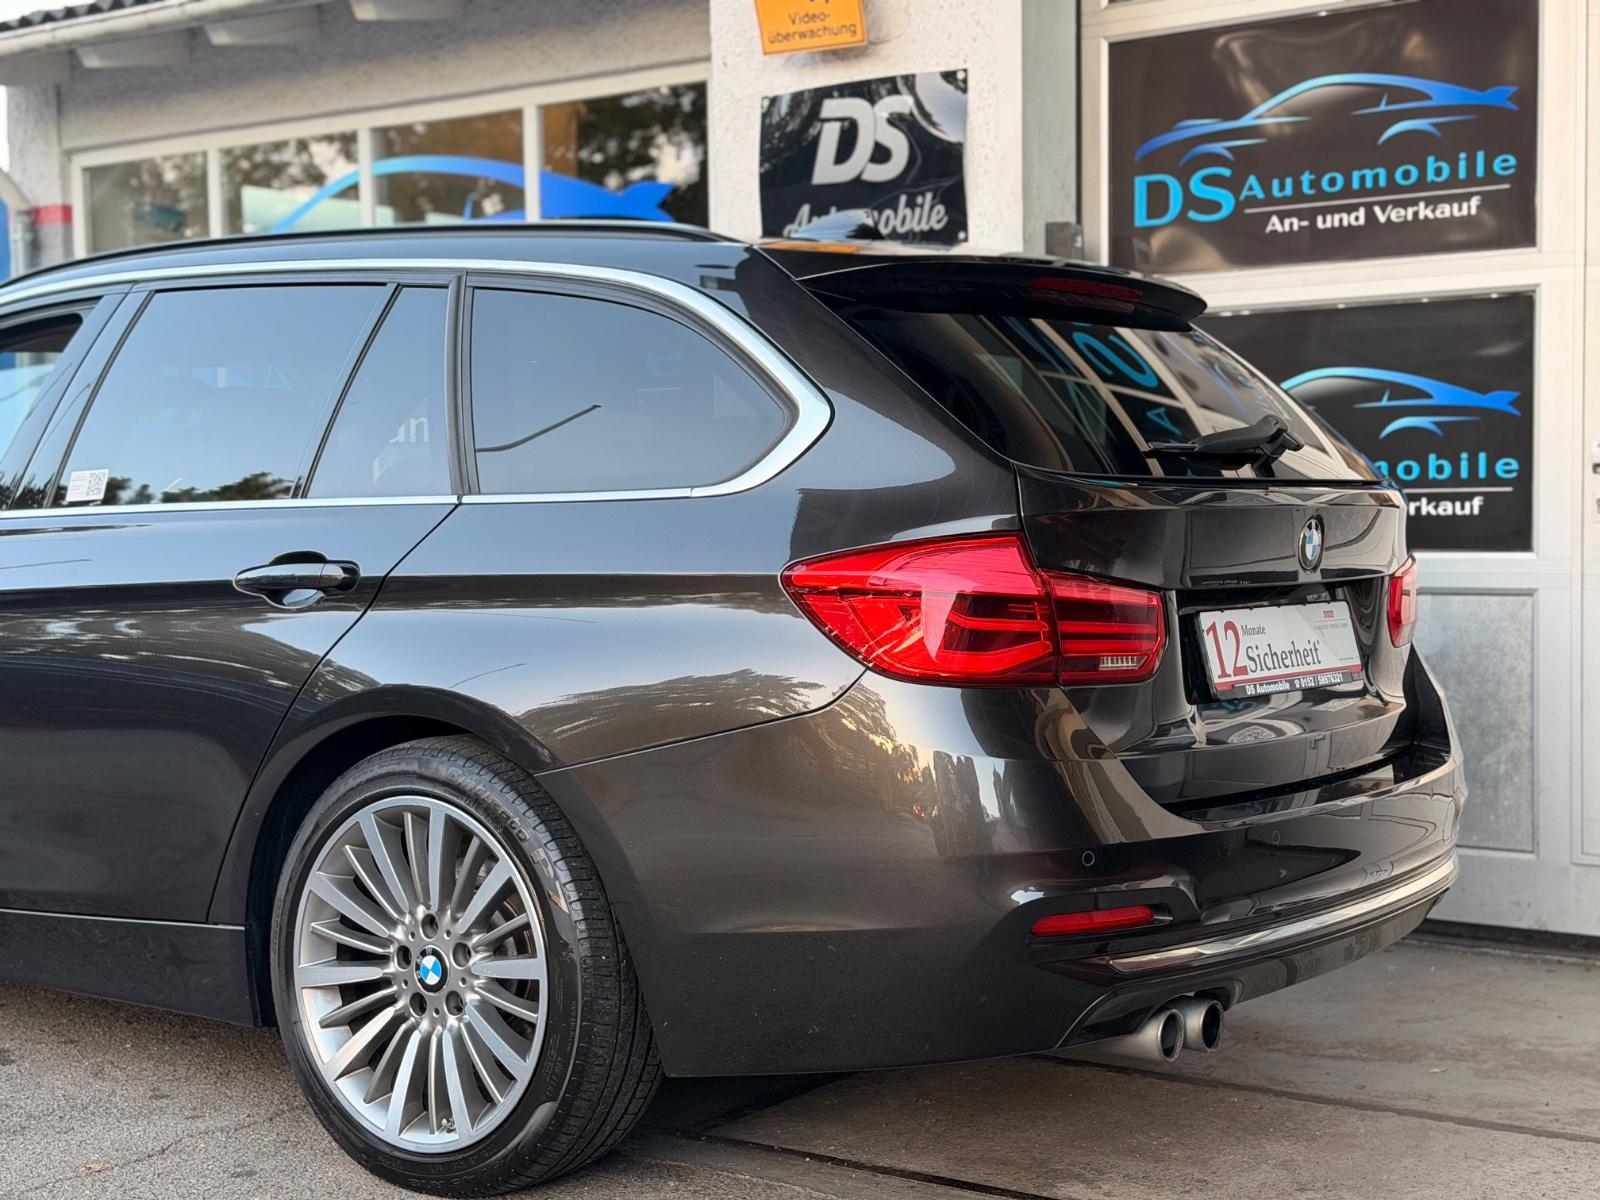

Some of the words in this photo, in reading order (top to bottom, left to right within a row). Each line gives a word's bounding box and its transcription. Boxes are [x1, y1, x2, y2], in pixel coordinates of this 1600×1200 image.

[767, 23, 857, 44] überwachung
[787, 11, 830, 25] Video-
[811, 94, 914, 186] DS
[1133, 166, 1236, 229] DS
[1239, 150, 1518, 202] Automobile
[783, 192, 948, 238] Aobile
[1265, 214, 1309, 234] An-
[1316, 206, 1367, 229] und
[1373, 196, 1482, 224] Verkauf
[1407, 496, 1484, 516] rkauf
[1205, 620, 1250, 679] 12
[1241, 624, 1267, 638] Monate
[1245, 684, 1256, 696] DS
[1256, 680, 1291, 695] Automobile
[1300, 675, 1315, 688] 0152
